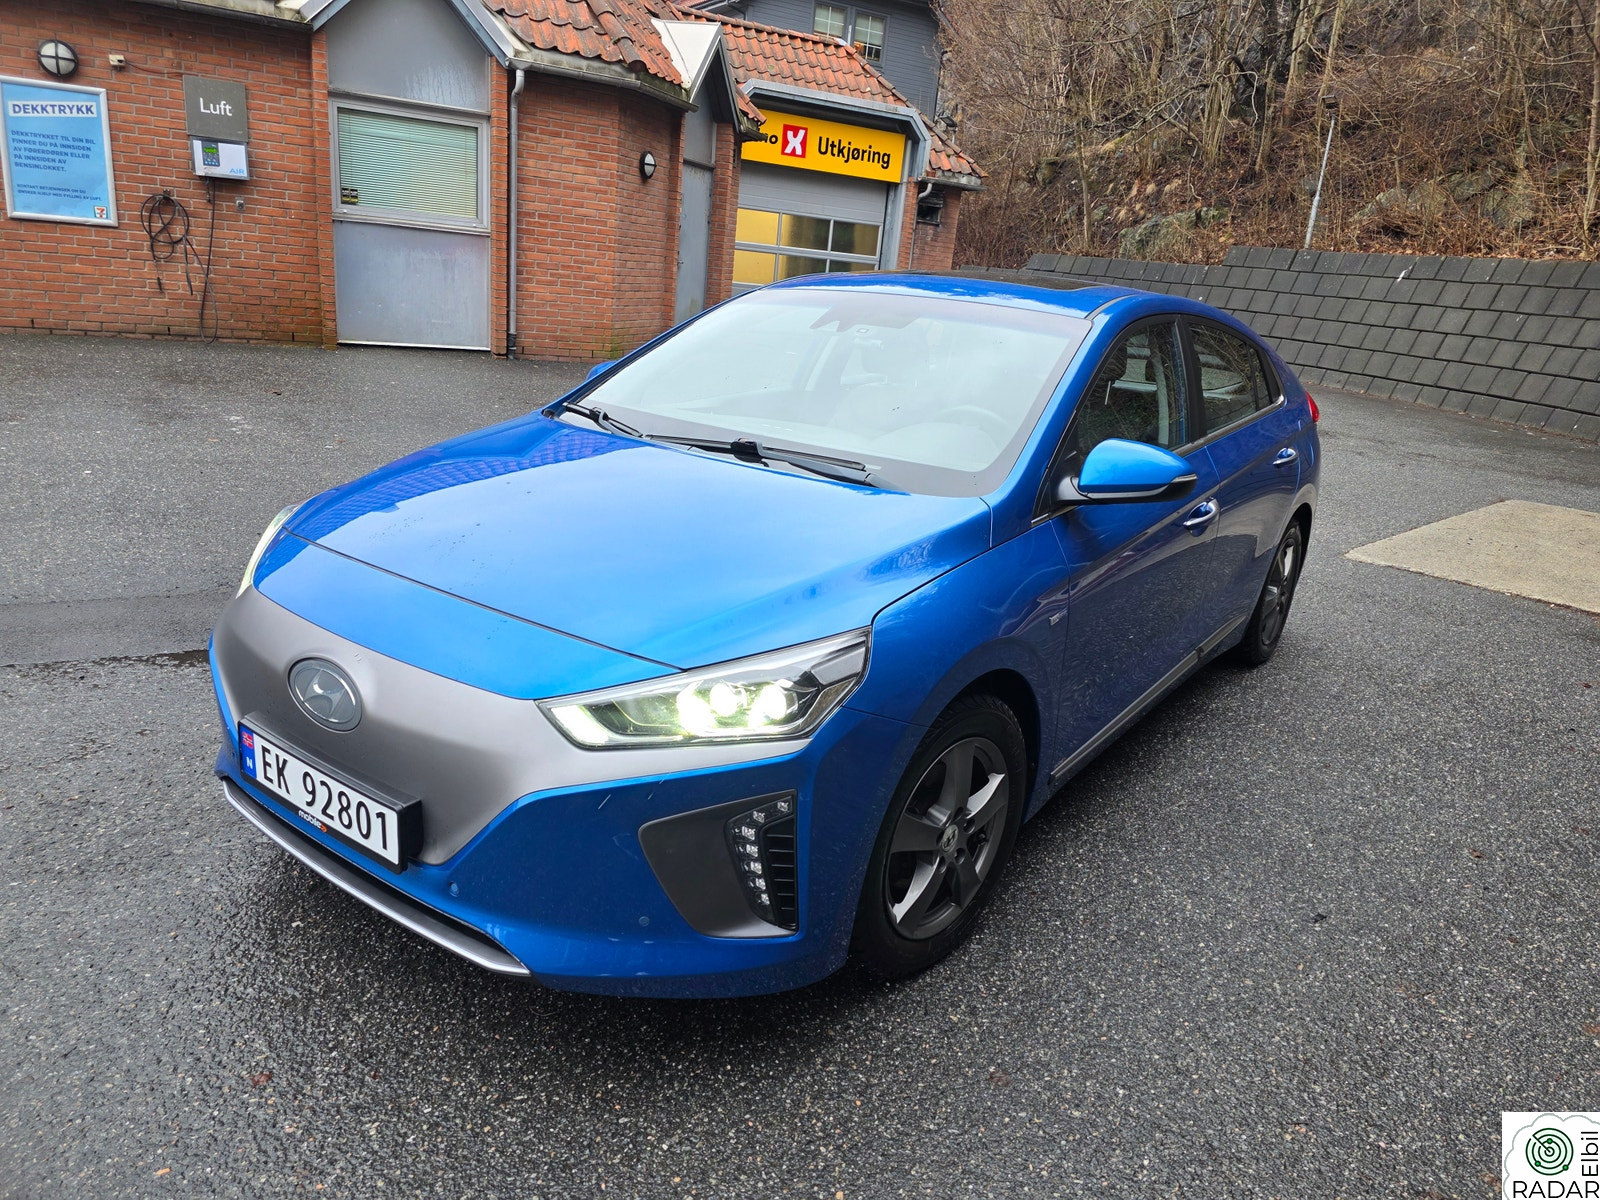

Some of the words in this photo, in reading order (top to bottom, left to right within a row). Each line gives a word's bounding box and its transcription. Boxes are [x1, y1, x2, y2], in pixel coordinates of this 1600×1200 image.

[12, 103, 95, 115] DEKKTRYKK
[199, 97, 233, 117] Luft
[11, 130, 59, 140] DEKKTRYKKET
[12, 138, 37, 146] FINNER
[60, 144, 92, 152] INNSIDEN
[24, 155, 57, 164] INNSIDEN
[817, 135, 892, 170] Utkjøring
[246, 756, 253, 770] N
[261, 744, 291, 796] EK
[302, 771, 388, 851] 92801
